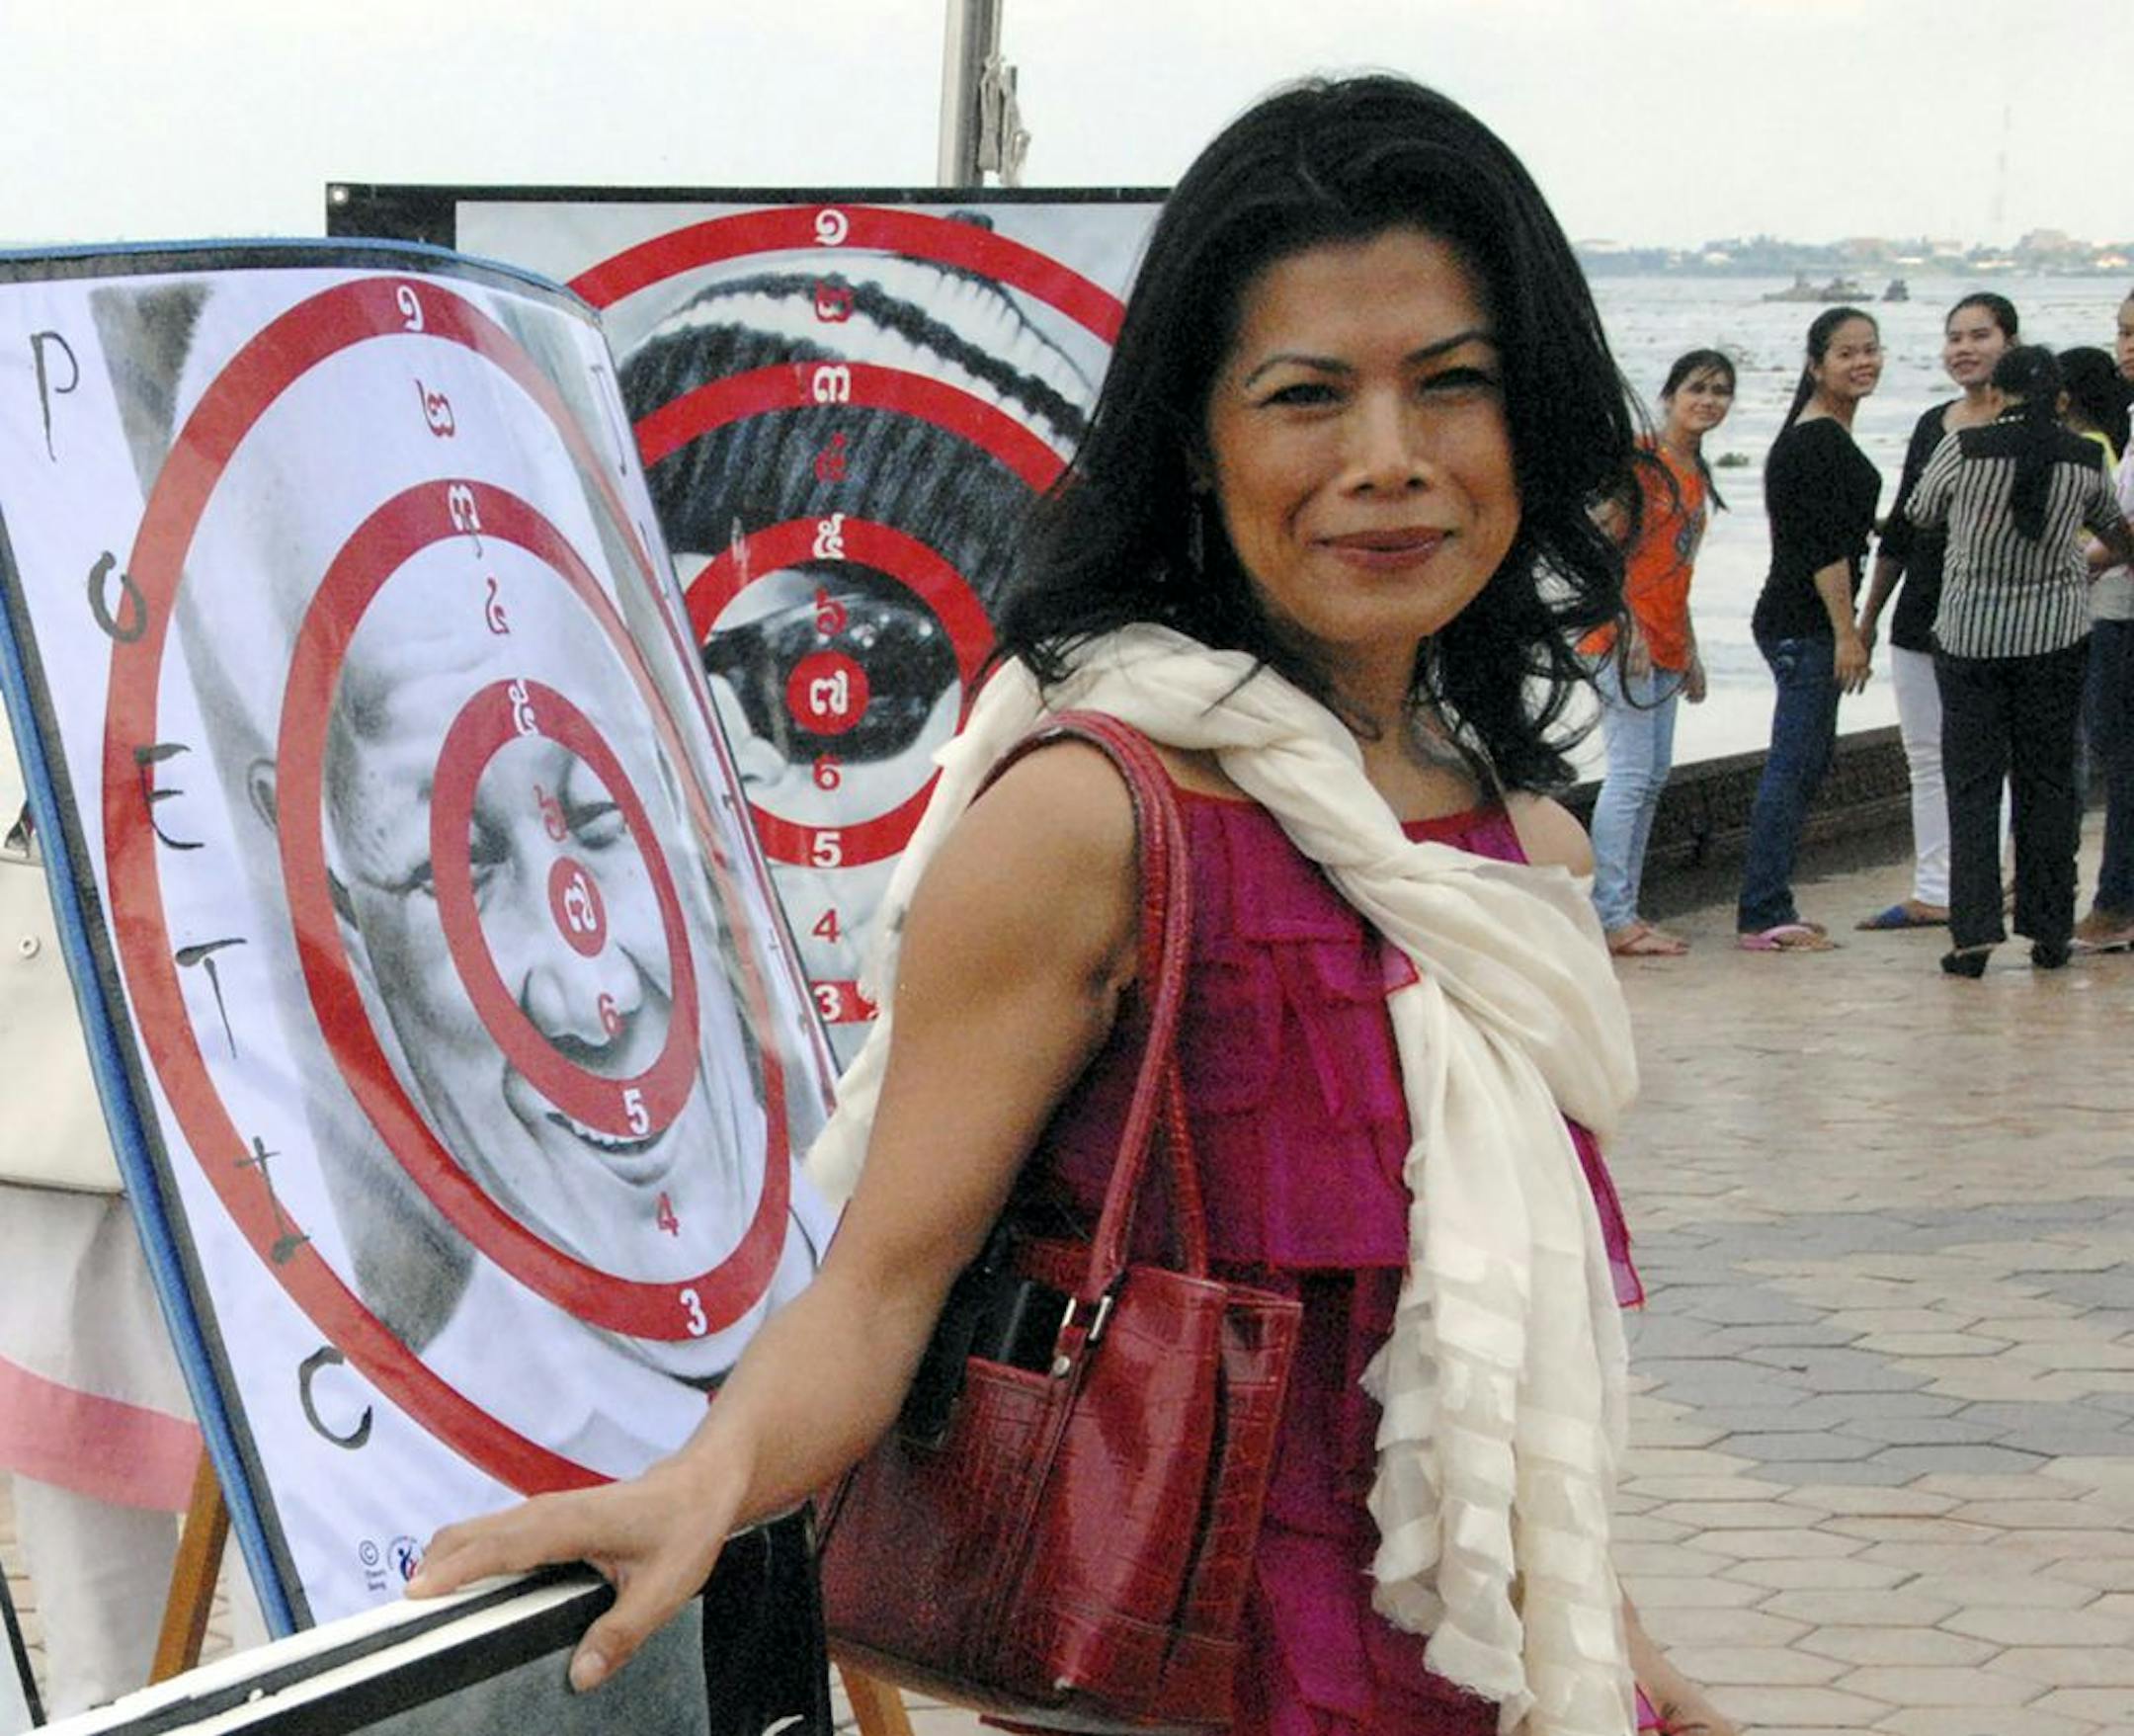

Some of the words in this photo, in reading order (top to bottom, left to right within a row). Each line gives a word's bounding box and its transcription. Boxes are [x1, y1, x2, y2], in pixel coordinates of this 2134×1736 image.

[813, 754, 841, 790] 6
[813, 831, 842, 867] 5
[812, 908, 840, 943] 4
[599, 993, 624, 1034] 6
[813, 985, 842, 1021] 3
[623, 1088, 649, 1134] 5
[657, 1191, 679, 1236] 4
[680, 1288, 707, 1337] 3
